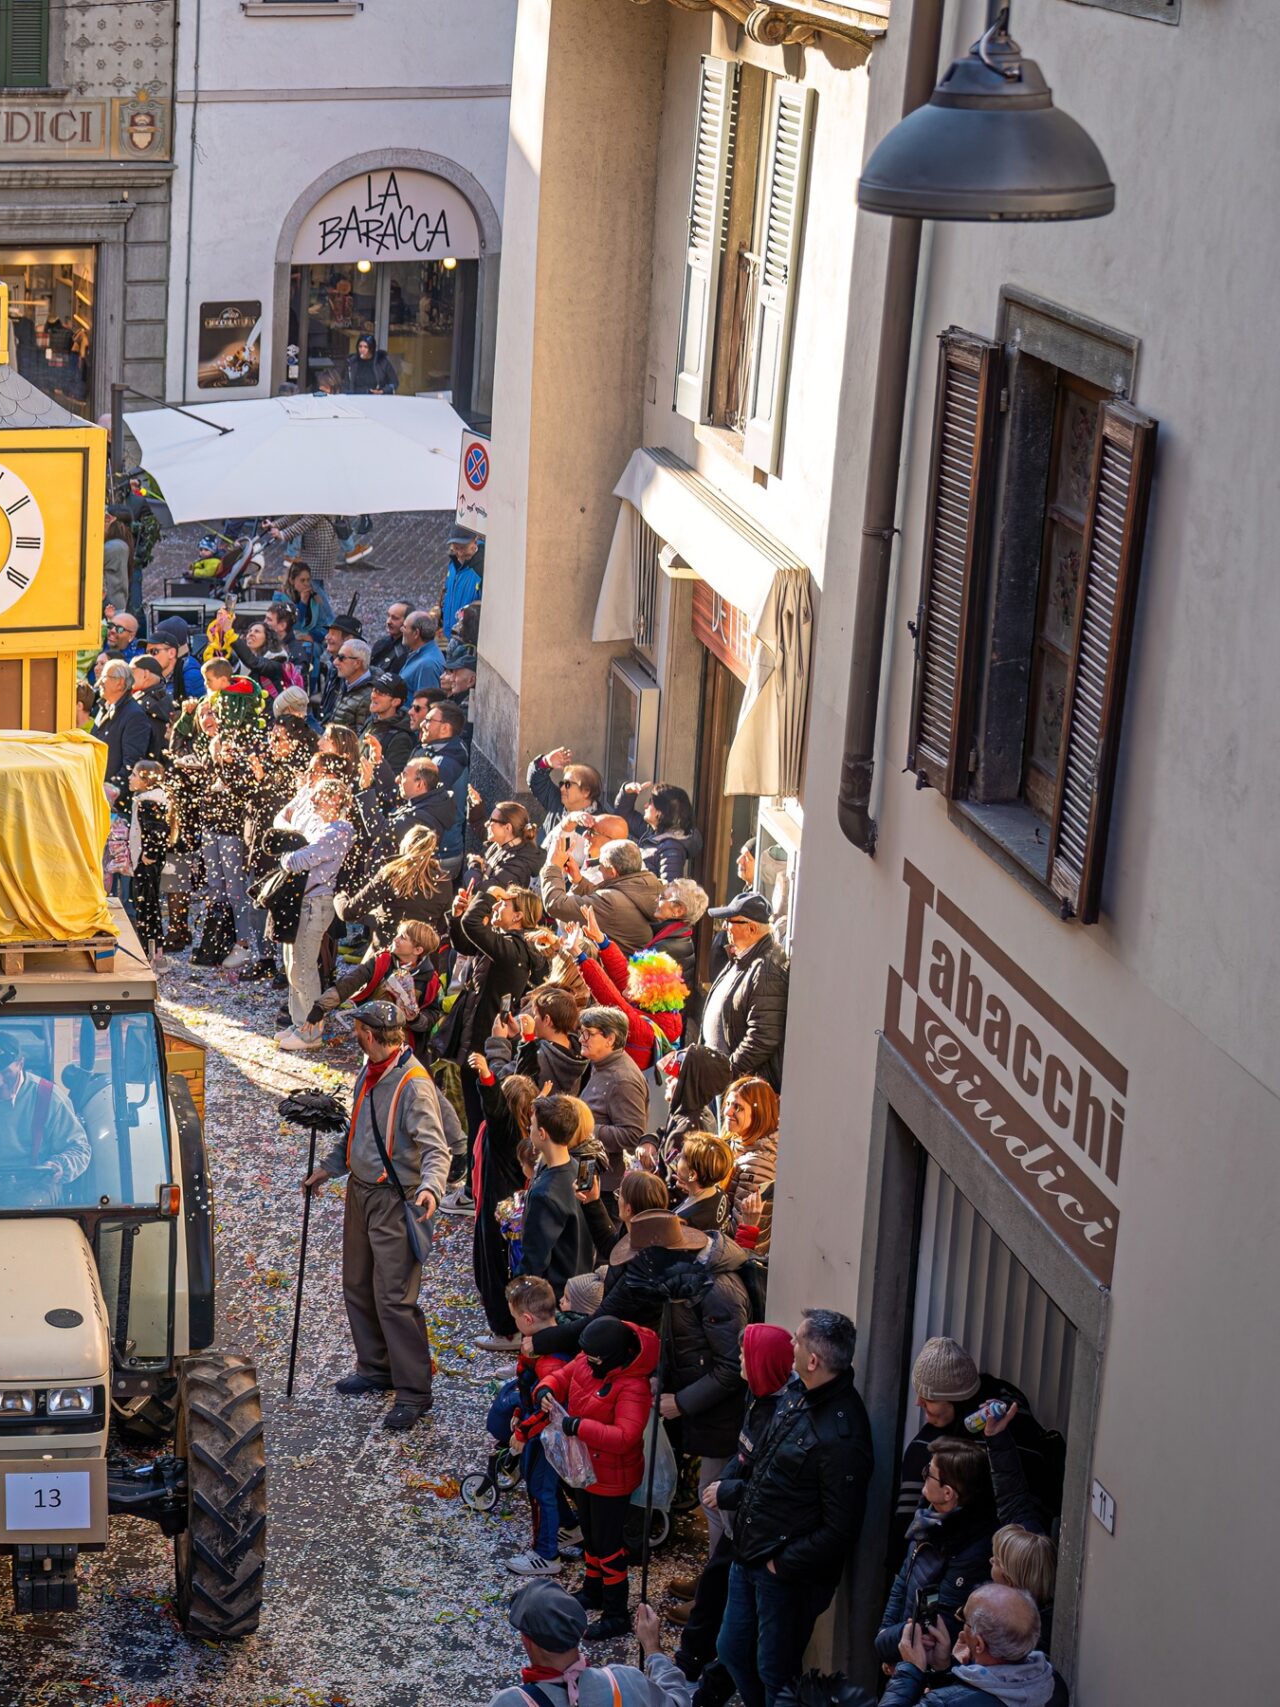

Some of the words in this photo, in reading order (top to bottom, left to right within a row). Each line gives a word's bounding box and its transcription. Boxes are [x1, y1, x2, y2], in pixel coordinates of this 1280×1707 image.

[364, 171, 403, 216] LA
[318, 204, 451, 256] BARACCA
[903, 857, 1126, 1187] Tabacchi
[924, 1018, 1116, 1249] Giudici
[33, 1488, 62, 1508] 13
[1099, 1491, 1107, 1521] 11
